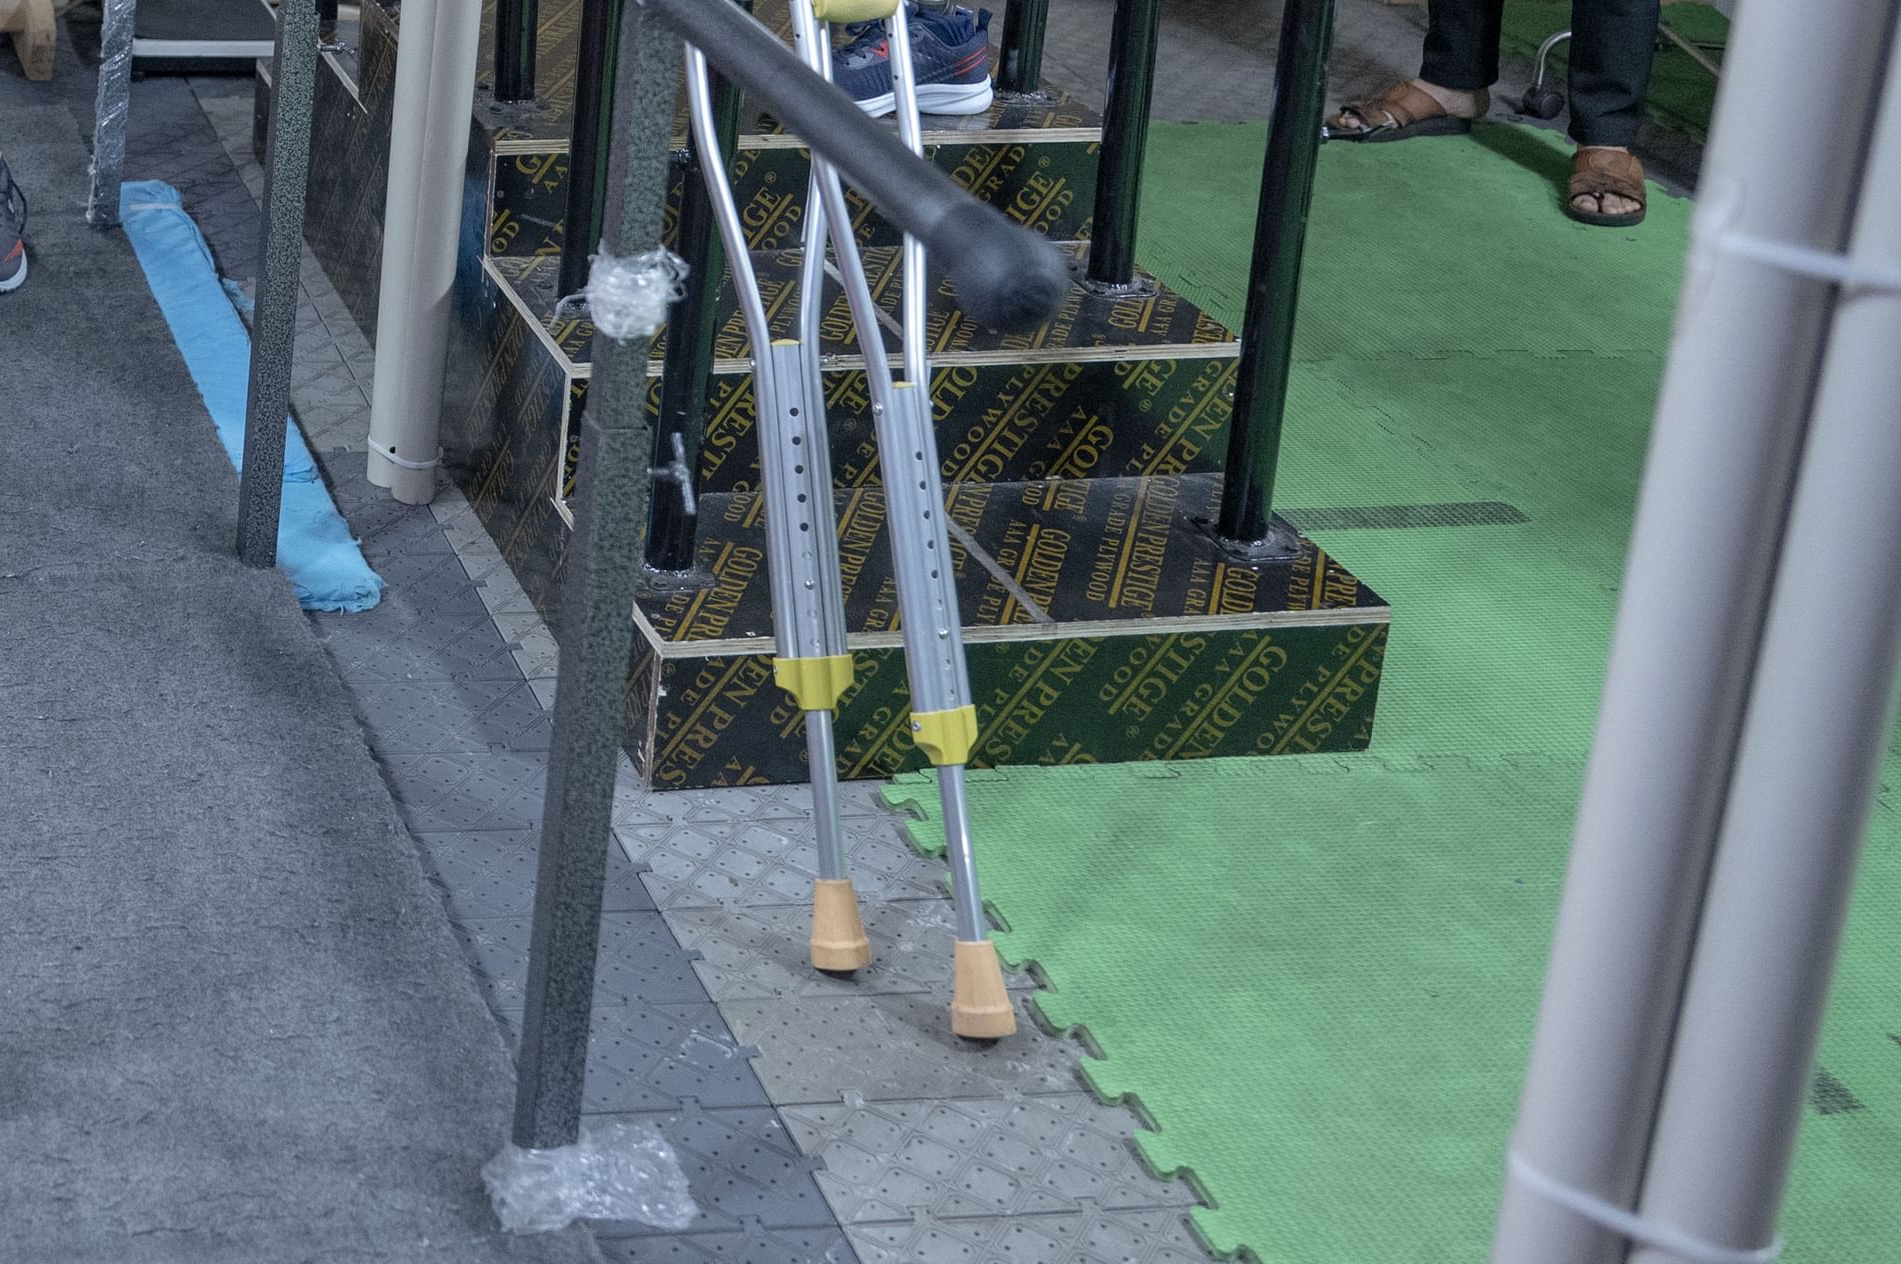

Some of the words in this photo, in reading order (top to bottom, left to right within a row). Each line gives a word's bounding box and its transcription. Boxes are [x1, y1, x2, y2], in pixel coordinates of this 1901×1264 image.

[941, 369, 1035, 478] PLYWOOD
[1047, 407, 1087, 453] AAA
[1154, 360, 1222, 437] GRADE
[844, 489, 888, 554] GOLDEN
[1005, 519, 1027, 544] AAA
[1107, 493, 1131, 536] GRADE
[1141, 476, 1179, 533] GOLDEN
[706, 546, 763, 616] GOLDEN
[1026, 528, 1071, 596] GOLDEN
[1086, 536, 1120, 602] PLYWOOD
[1191, 558, 1212, 583] AAA
